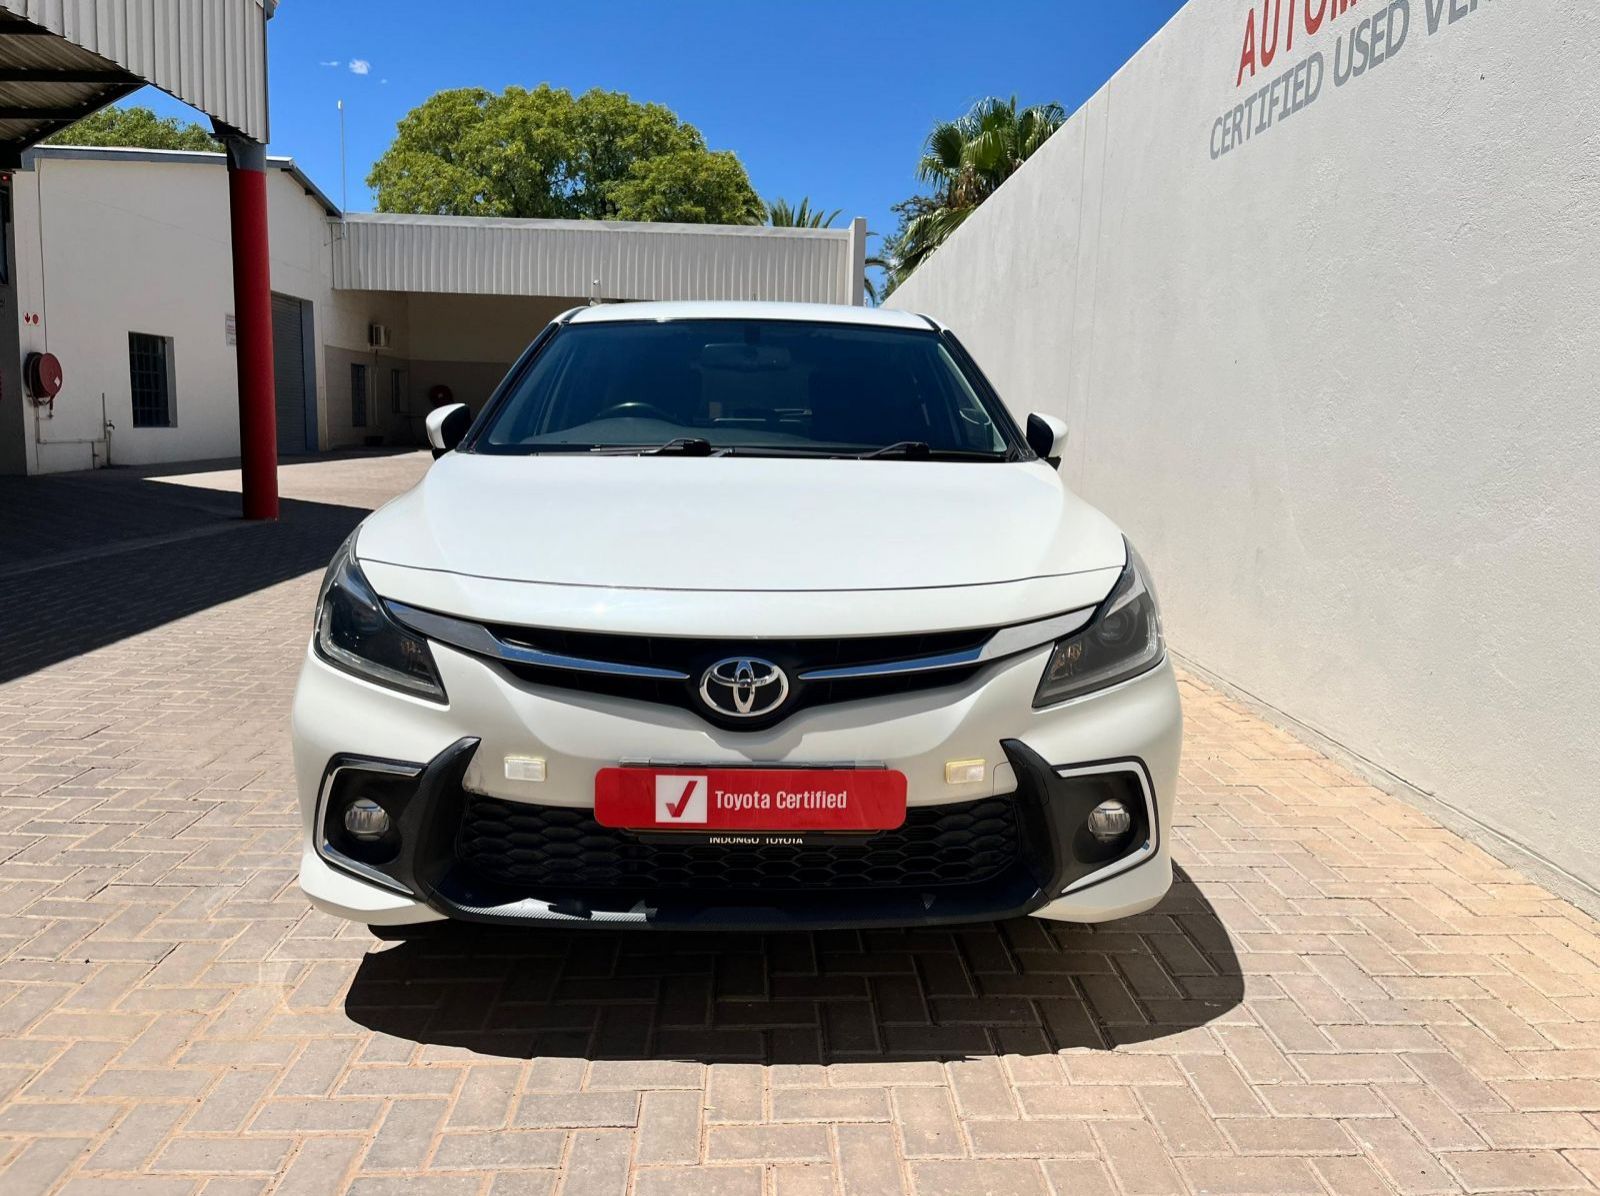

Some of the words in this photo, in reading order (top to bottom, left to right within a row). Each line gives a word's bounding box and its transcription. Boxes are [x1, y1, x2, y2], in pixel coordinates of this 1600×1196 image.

[1209, 51, 1324, 160] CERTIFIED
[1333, 0, 1410, 88] USED
[714, 790, 771, 811] Toyota
[776, 790, 847, 809] Certified
